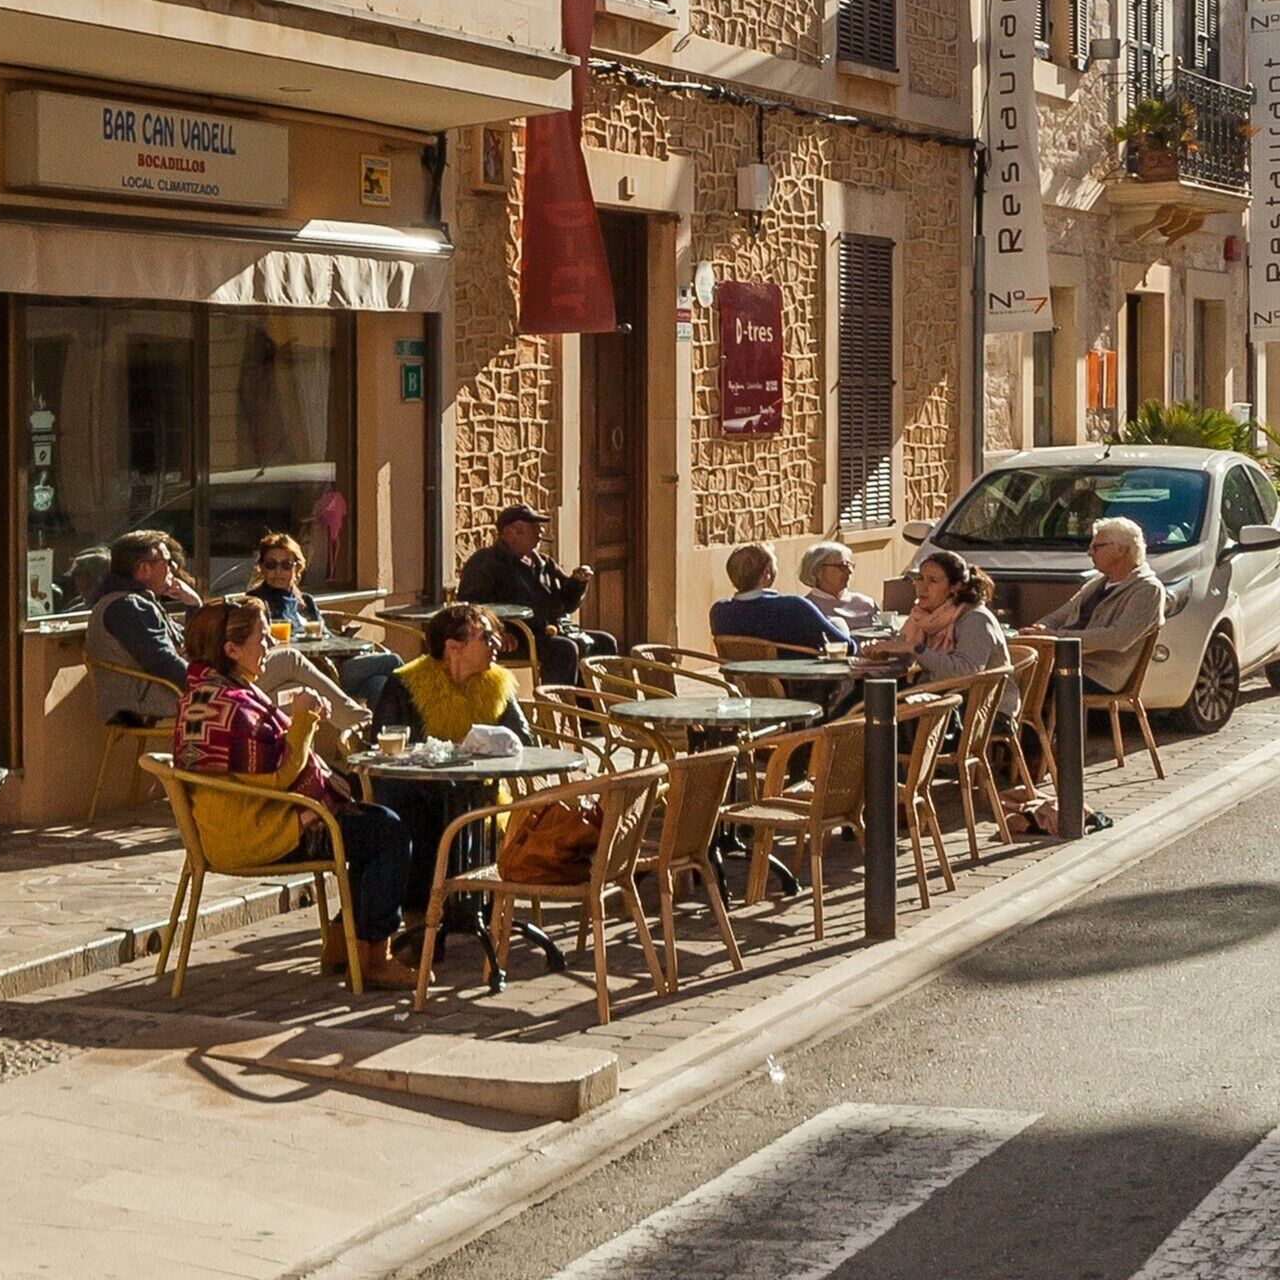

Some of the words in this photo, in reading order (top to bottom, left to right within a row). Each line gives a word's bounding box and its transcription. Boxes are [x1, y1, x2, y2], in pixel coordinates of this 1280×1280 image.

[103, 108, 136, 143] BAR
[142, 113, 174, 147] CAN
[181, 118, 236, 155] VADELL
[138, 154, 206, 173] BOCADILLOS
[122, 176, 154, 189] LOCAL
[157, 179, 219, 196] CLIMATIZADO
[736, 317, 774, 345] D-tres
